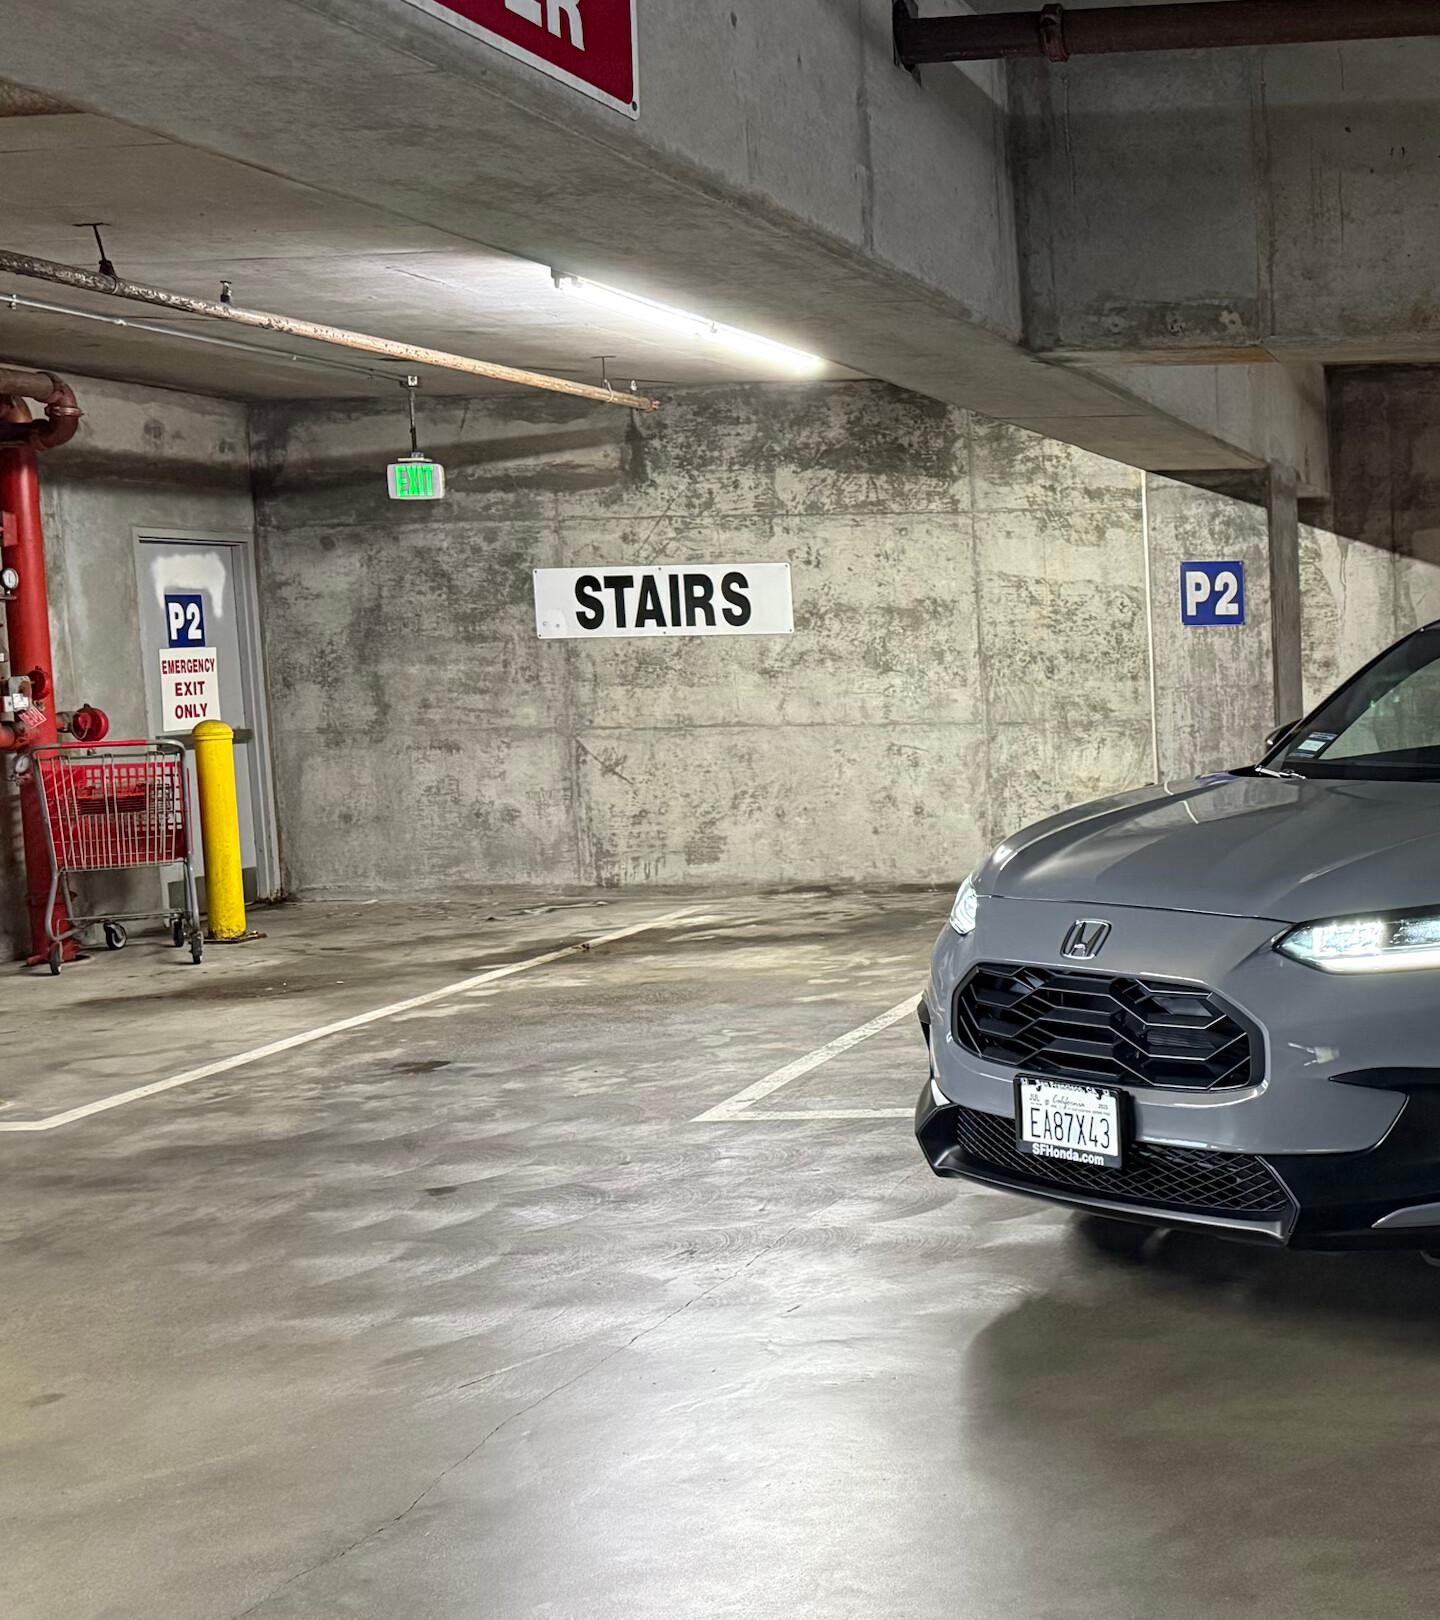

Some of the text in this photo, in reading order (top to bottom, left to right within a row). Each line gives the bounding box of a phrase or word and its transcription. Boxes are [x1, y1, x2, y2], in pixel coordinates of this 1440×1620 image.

[396, 465, 433, 497] EXIT
[575, 571, 752, 630] STAIRS
[1186, 571, 1239, 616] P2
[168, 602, 203, 640] P2
[161, 658, 215, 675] EMERGENCY
[175, 681, 206, 697] EXIT
[175, 703, 208, 719] ONLY
[1030, 1107, 1110, 1149] EA87X43
[1032, 1142, 1105, 1167] SFHonda.com
